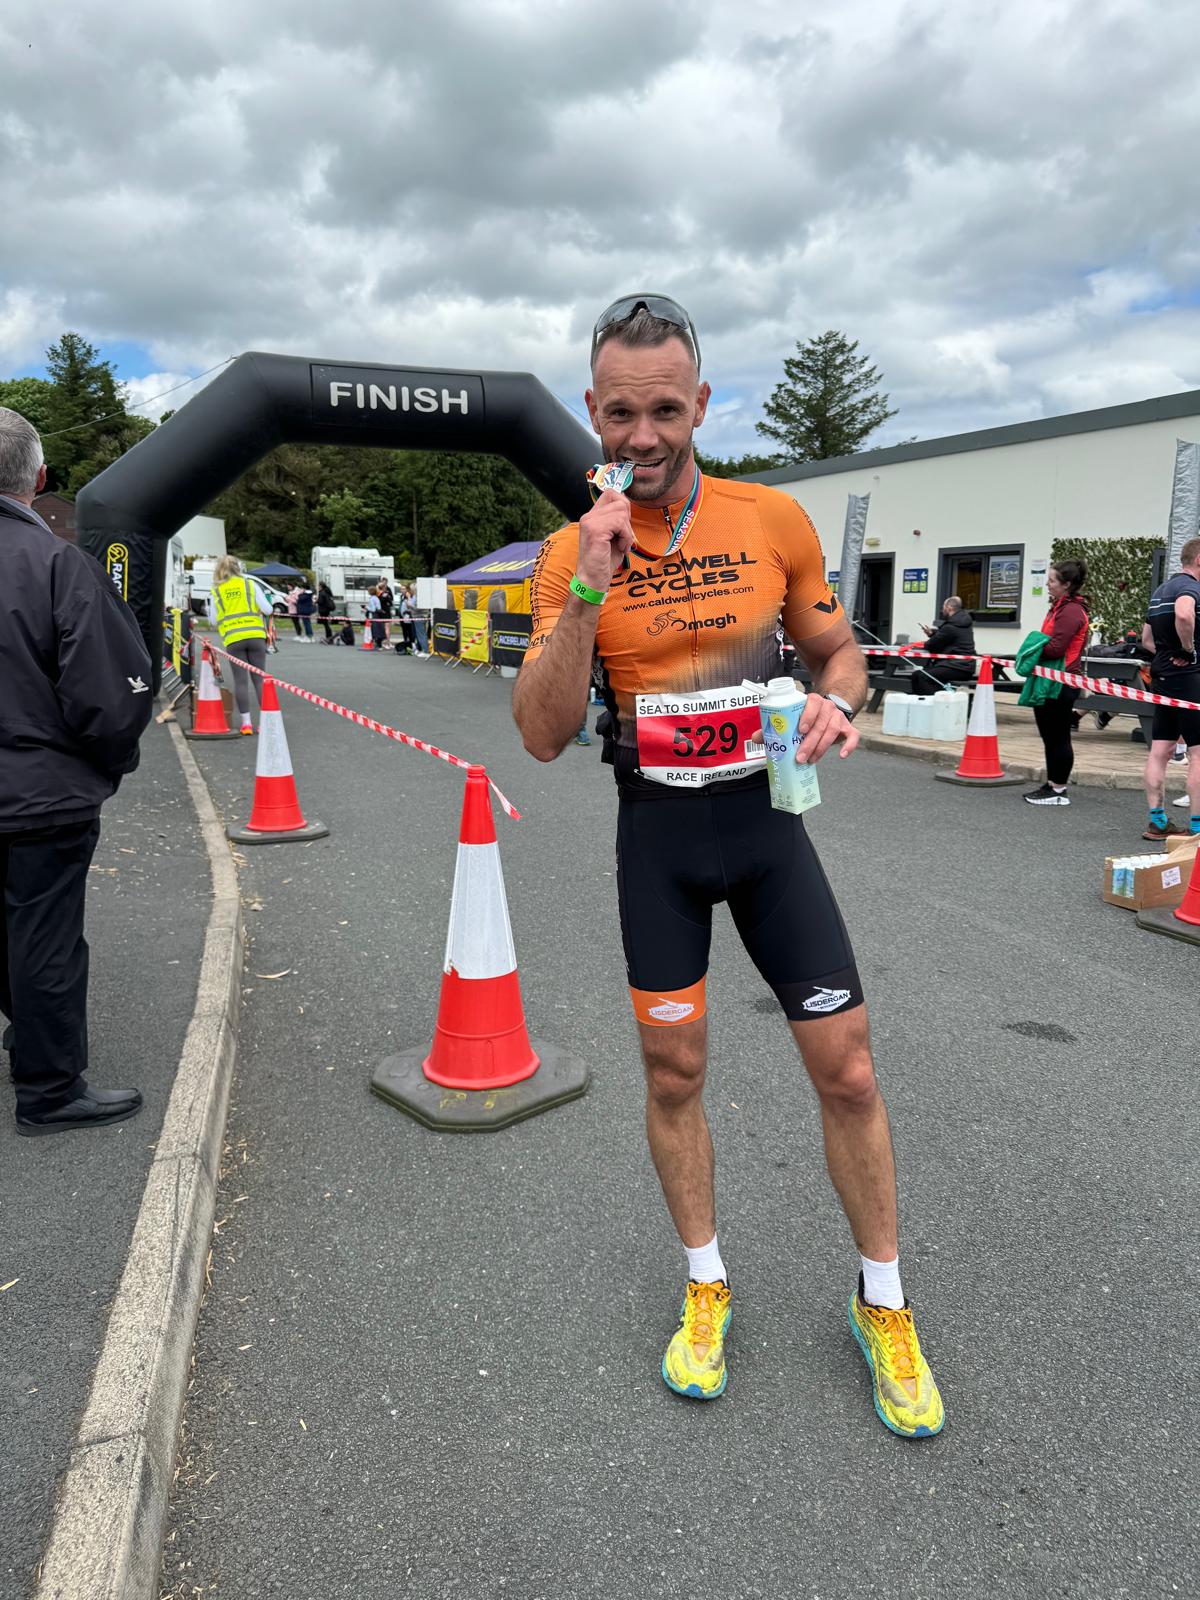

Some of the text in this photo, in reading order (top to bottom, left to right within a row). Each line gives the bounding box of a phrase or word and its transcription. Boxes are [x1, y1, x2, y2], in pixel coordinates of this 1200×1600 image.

[329, 381, 469, 415] FINISH
[609, 551, 758, 587] CALDWELL
[628, 568, 740, 598] CYCLES
[622, 585, 754, 612] www.caldwellcycles.com
[639, 704, 662, 715] SEA
[664, 704, 680, 714] TO
[682, 699, 727, 713] SUMMIT
[672, 721, 738, 758] 529
[666, 767, 747, 782] RACE IRELAND
[771, 754, 782, 792] WATER
